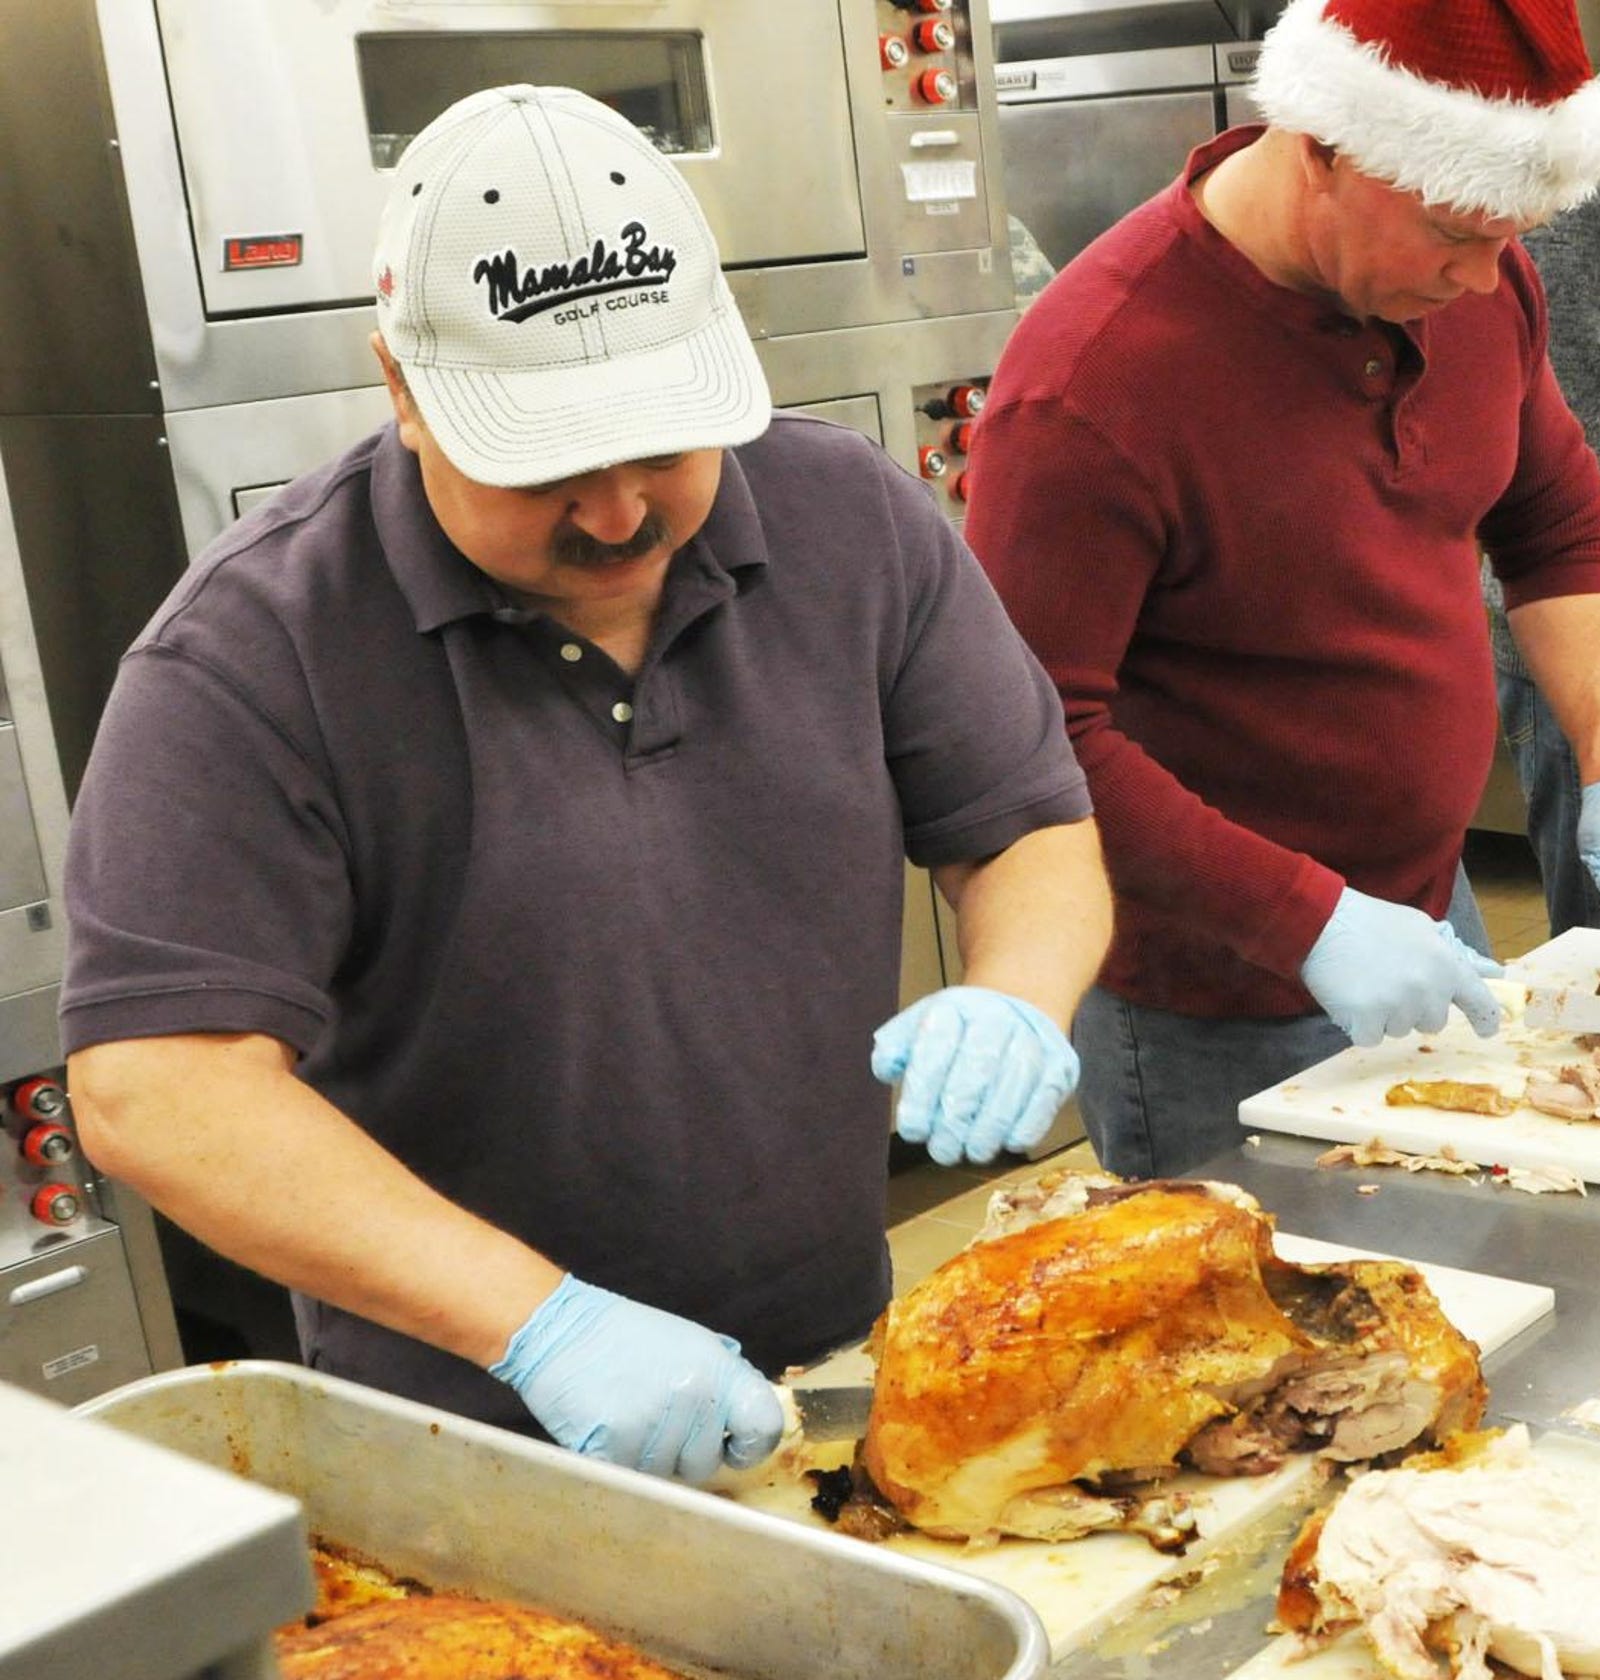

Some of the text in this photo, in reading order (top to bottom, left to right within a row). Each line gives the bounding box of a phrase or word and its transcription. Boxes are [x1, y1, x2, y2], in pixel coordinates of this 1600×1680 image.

[474, 221, 677, 315] Mamala Bay
[553, 290, 670, 325] GOLF COURSE
